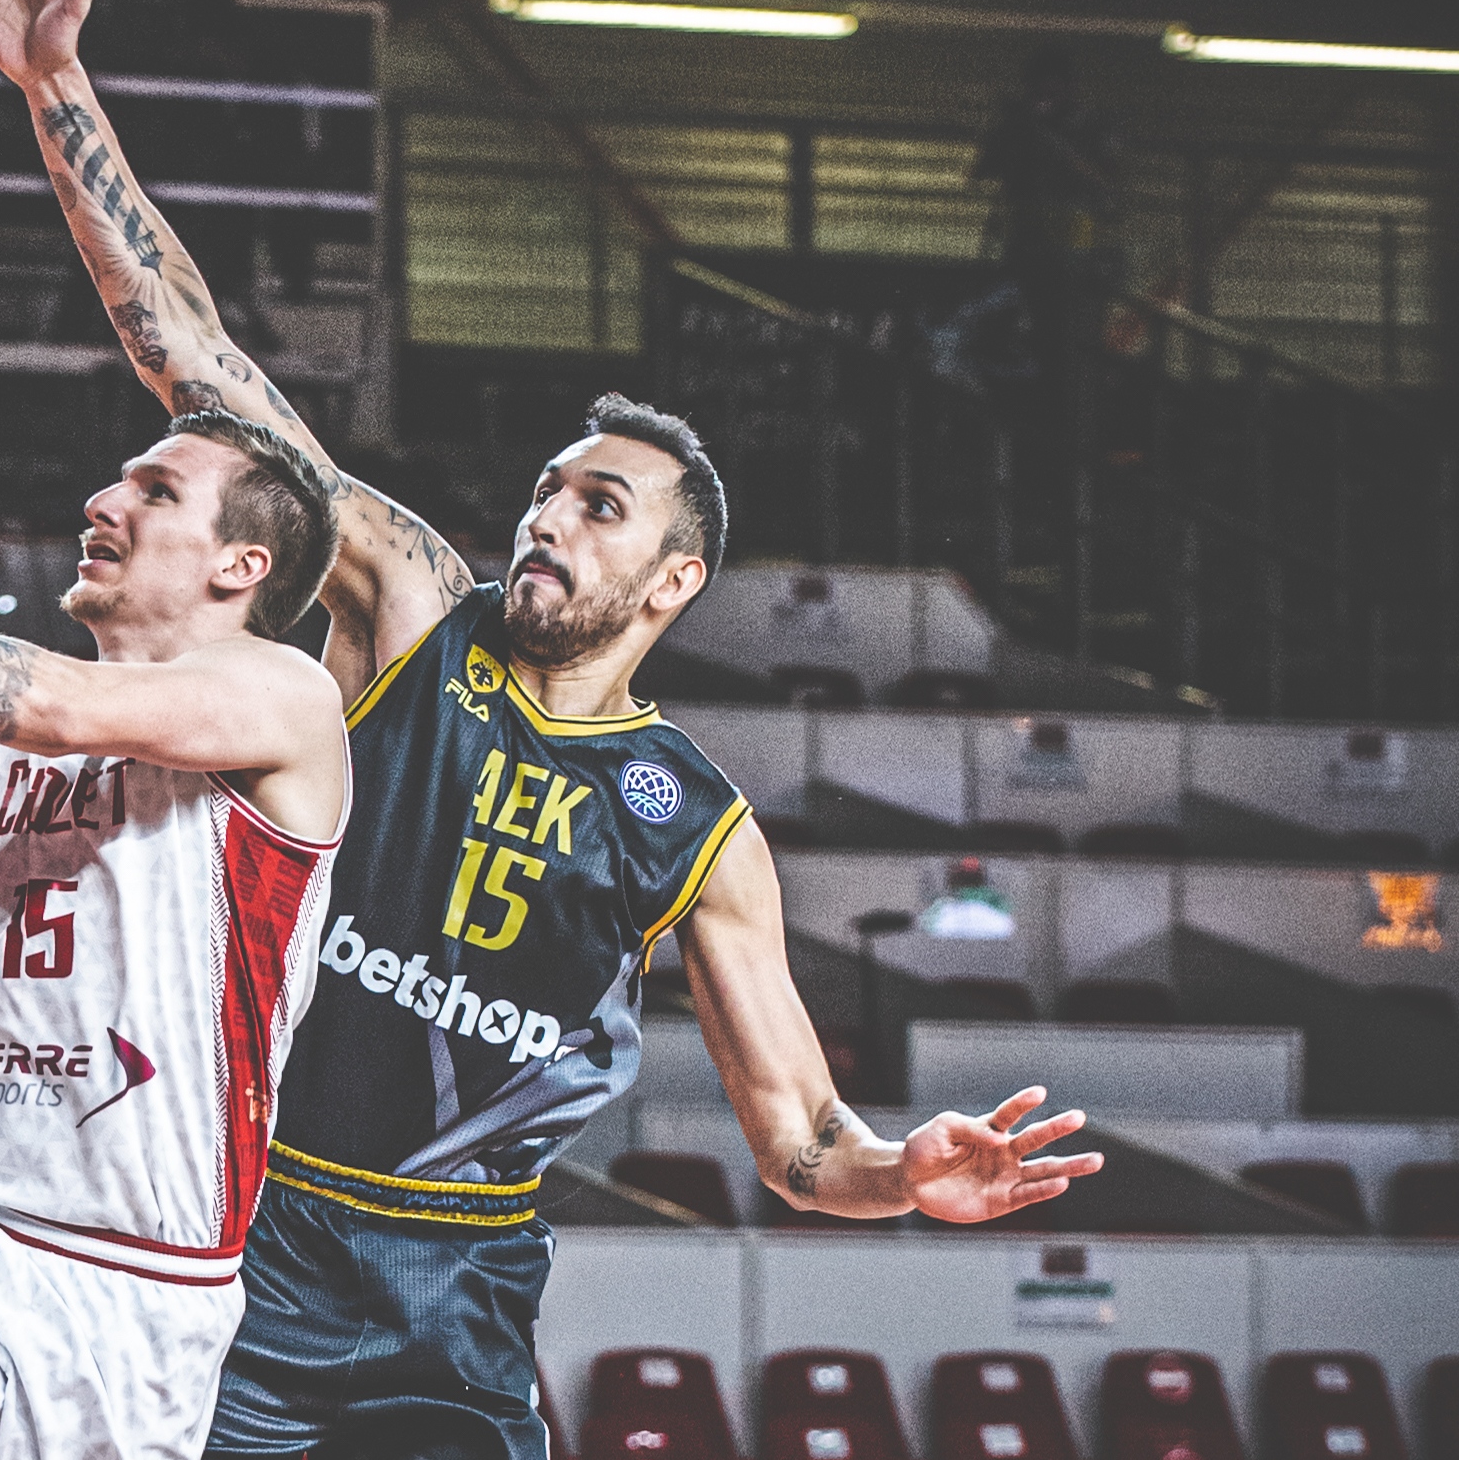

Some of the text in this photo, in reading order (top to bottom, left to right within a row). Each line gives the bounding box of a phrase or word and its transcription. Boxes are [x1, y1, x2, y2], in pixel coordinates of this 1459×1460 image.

[444, 678, 490, 723] FILA
[473, 748, 593, 856] AEK
[2, 878, 79, 979] 15
[442, 838, 548, 951] 15
[319, 915, 561, 1063] betshop
